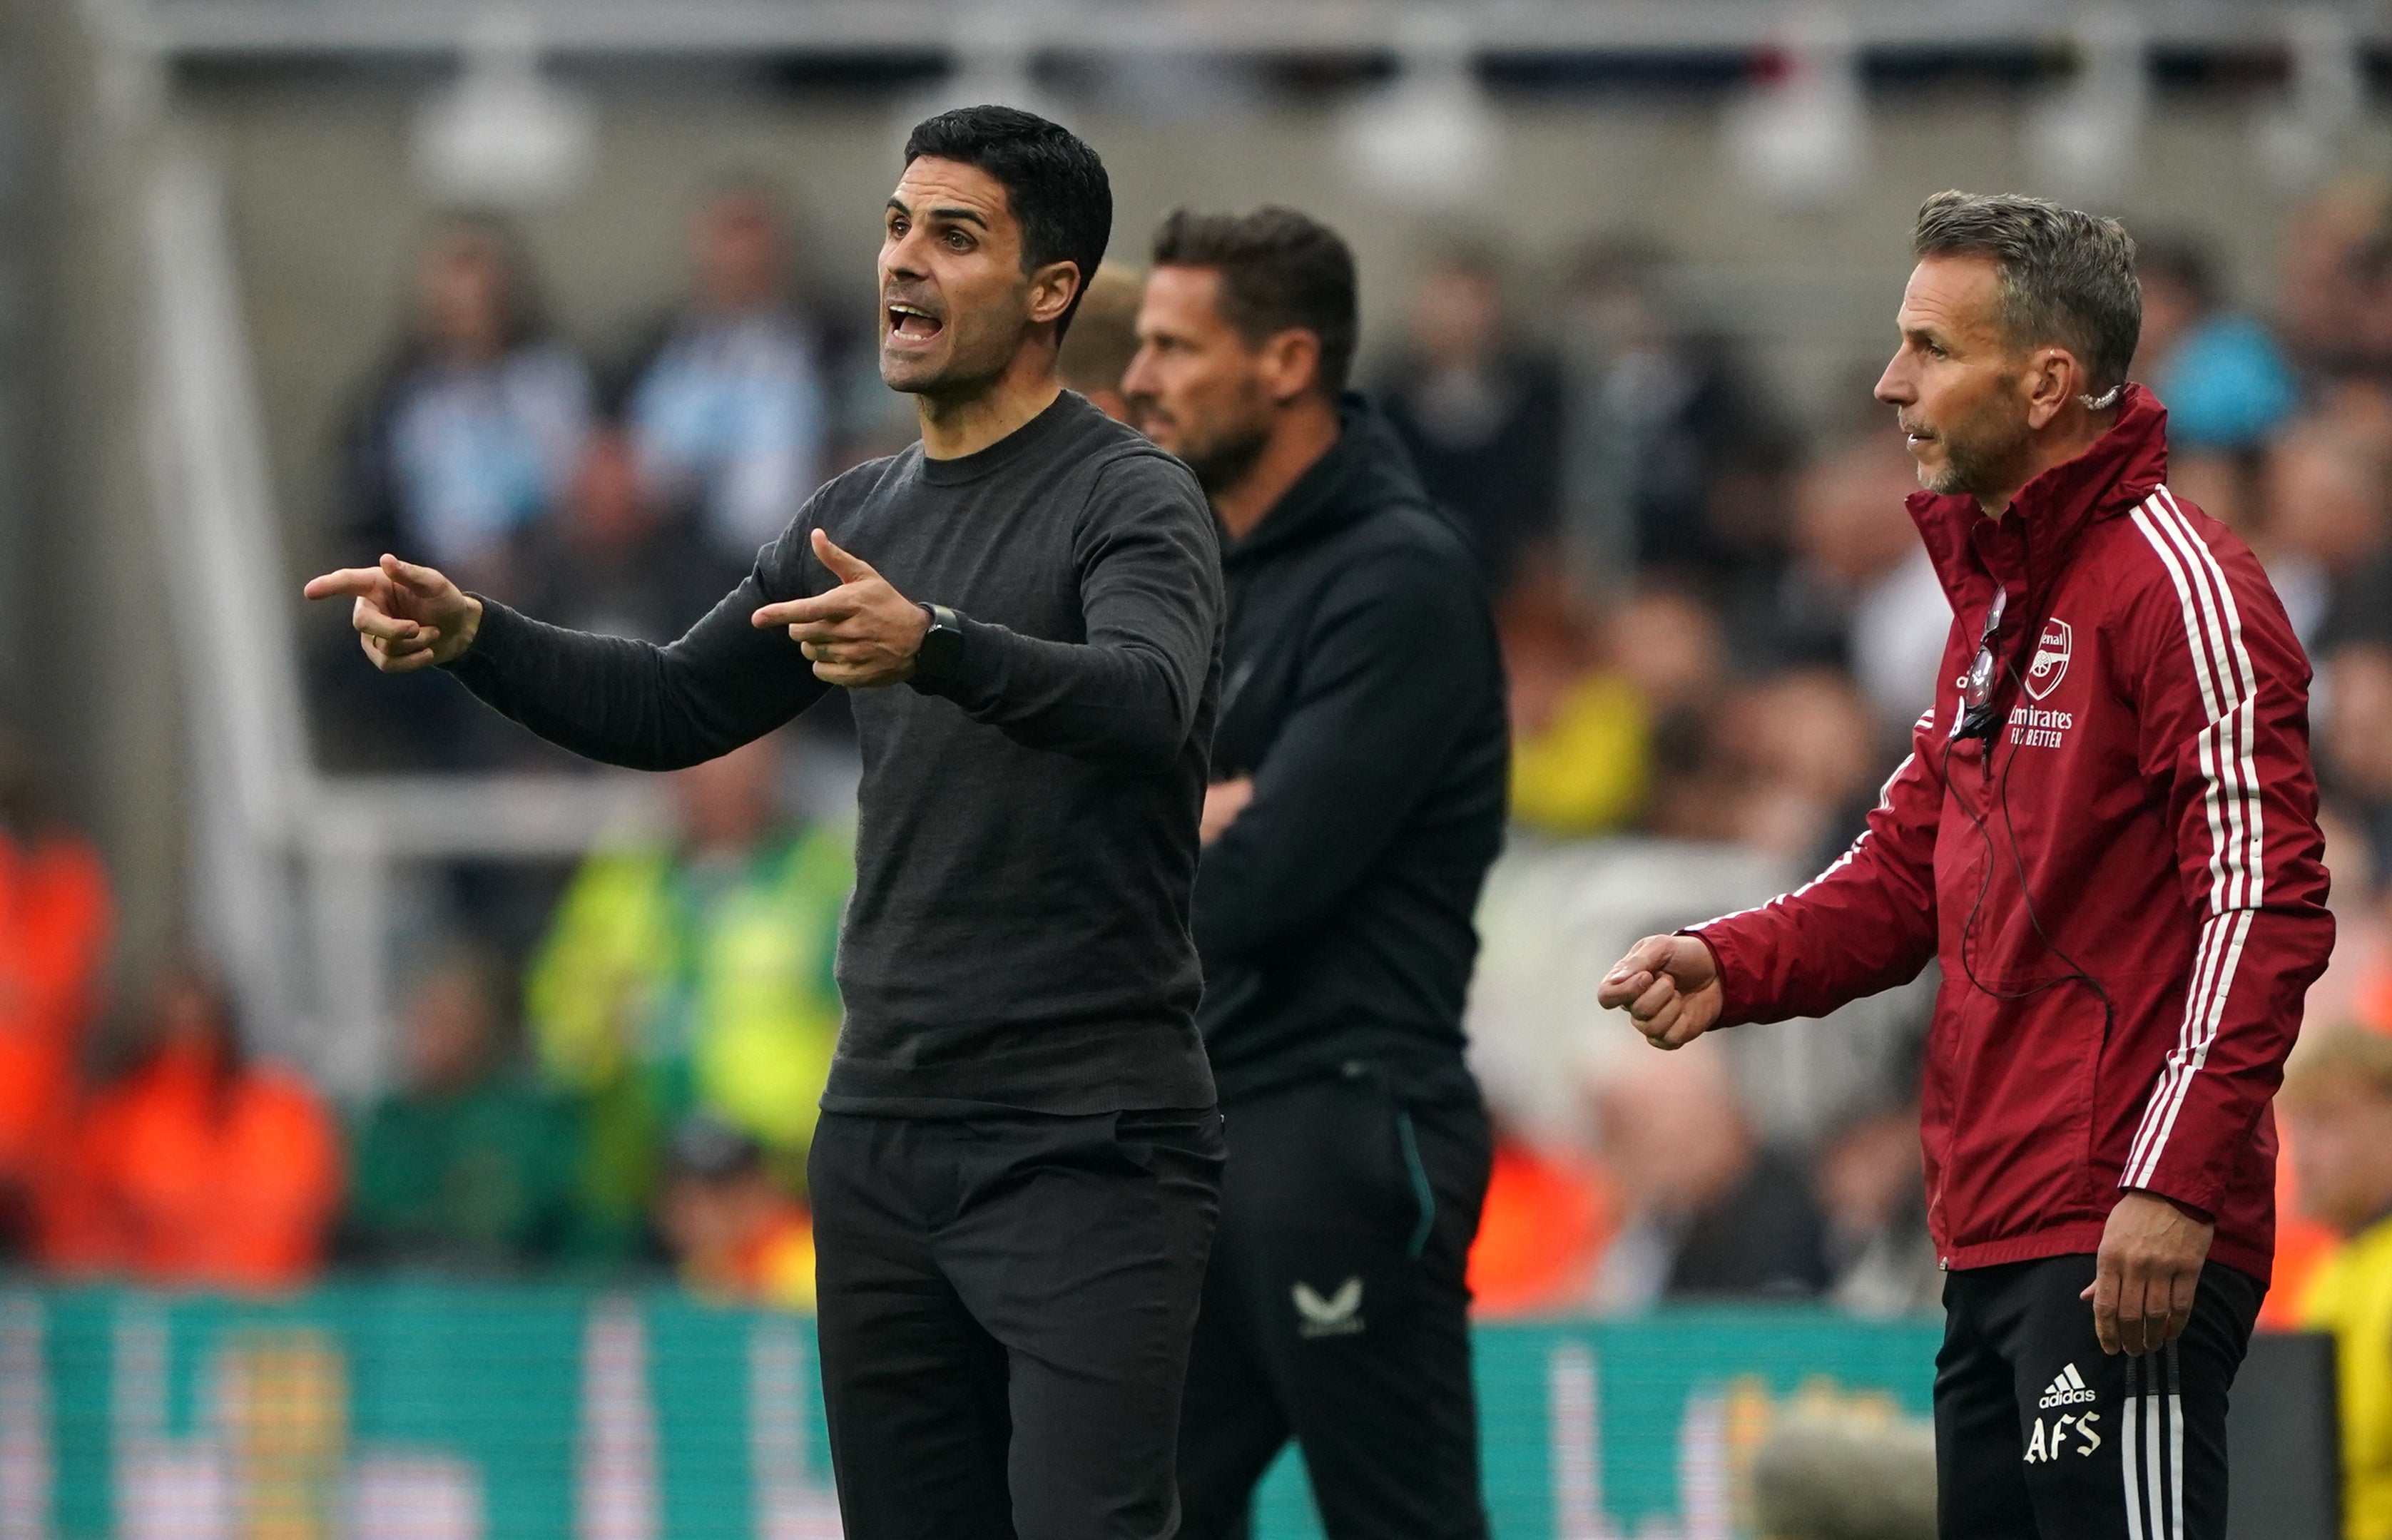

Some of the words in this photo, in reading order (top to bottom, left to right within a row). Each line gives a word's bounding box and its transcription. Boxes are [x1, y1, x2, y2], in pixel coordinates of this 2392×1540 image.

[2042, 633, 2063, 646] enal
[2025, 729, 2062, 748] BETTER
[2039, 1389, 2096, 1409] adidas
[2022, 1411, 2102, 1464] AFS
